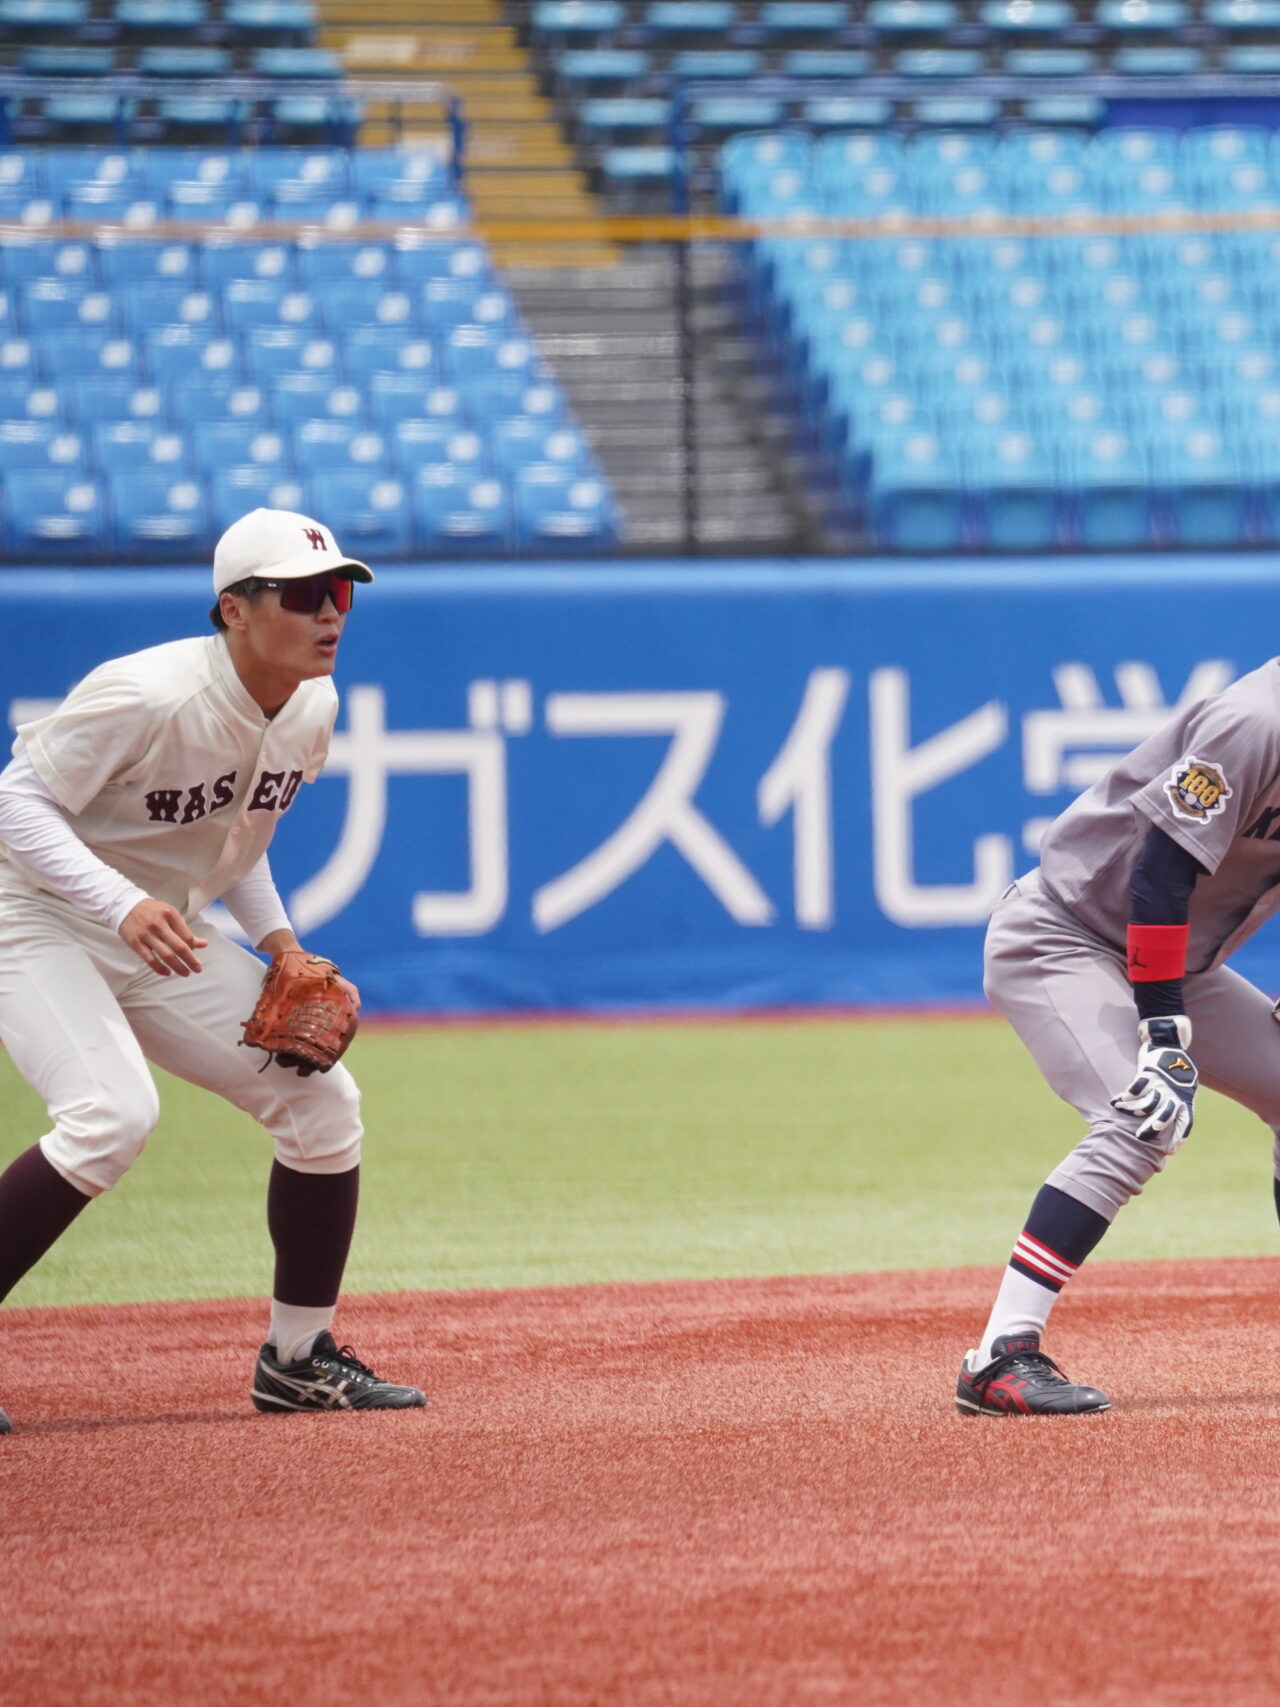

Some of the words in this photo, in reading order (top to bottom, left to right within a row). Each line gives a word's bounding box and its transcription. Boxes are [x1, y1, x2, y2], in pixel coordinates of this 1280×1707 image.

[301, 527, 328, 551] W
[8, 658, 1236, 940] ガス化
[144, 769, 304, 825] WASED
[1179, 768, 1220, 808] 100
